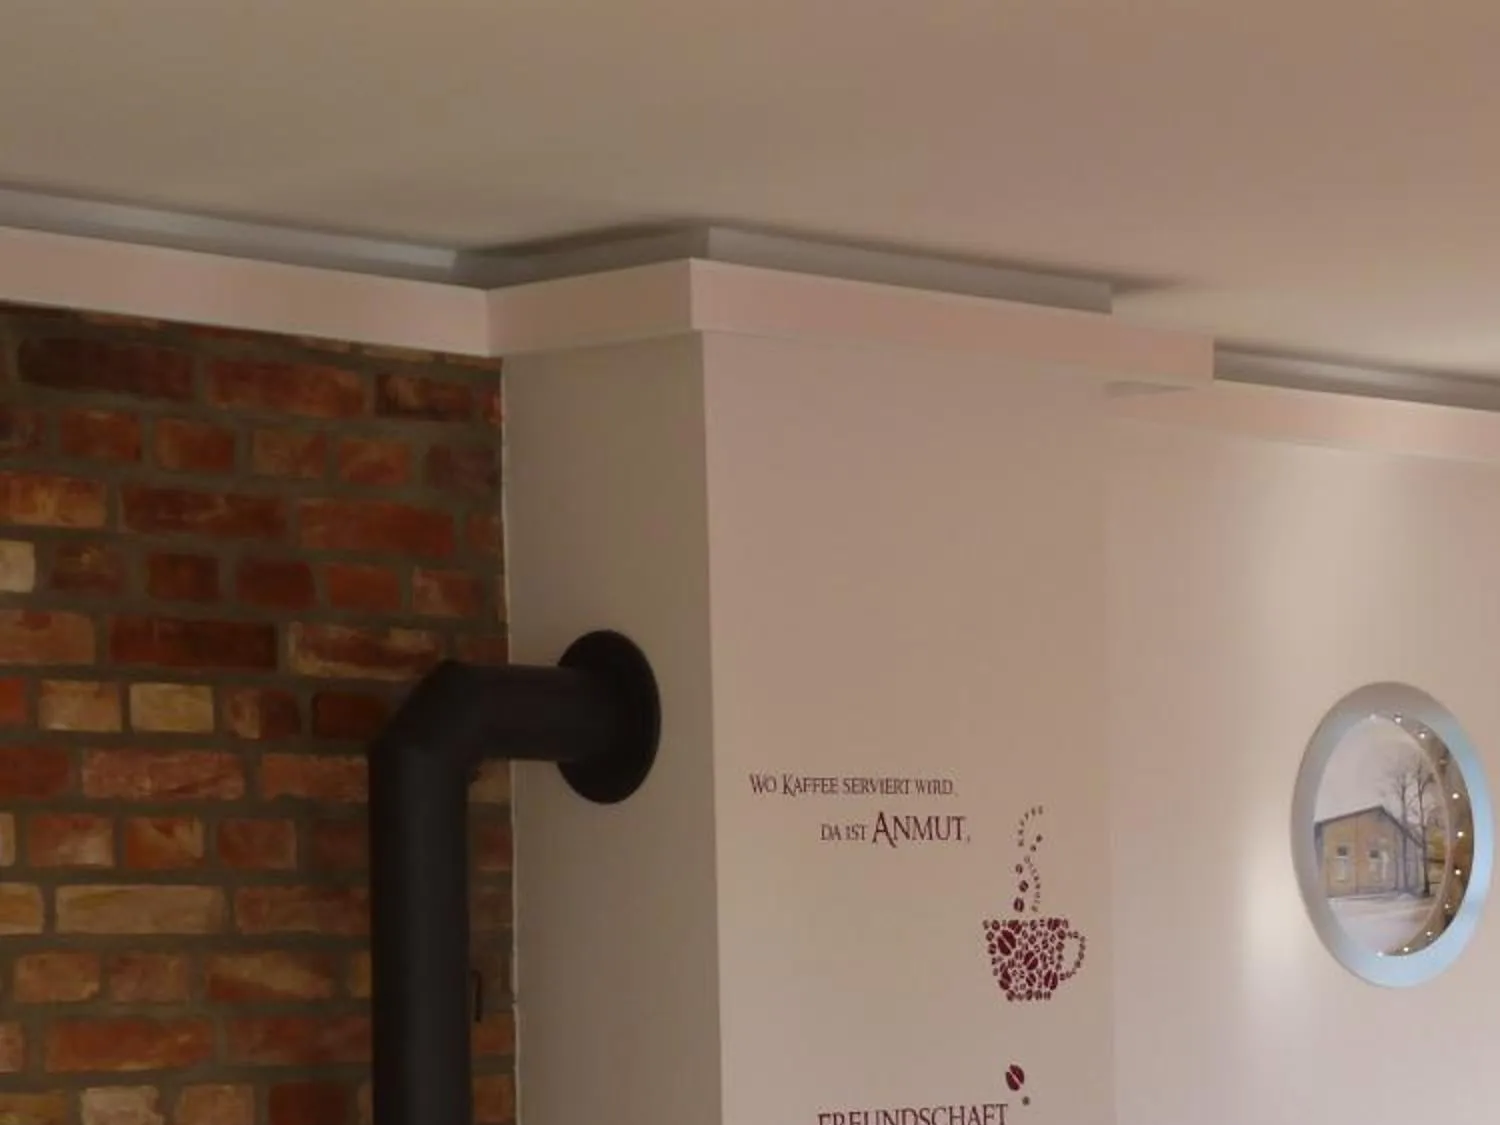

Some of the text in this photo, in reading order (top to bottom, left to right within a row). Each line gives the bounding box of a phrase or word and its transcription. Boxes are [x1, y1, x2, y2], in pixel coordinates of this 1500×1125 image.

[749, 773, 777, 794] WO
[782, 774, 839, 796] KAFFEE
[842, 777, 909, 795] SERVIERT
[820, 823, 841, 841] DA
[845, 823, 868, 841] IST
